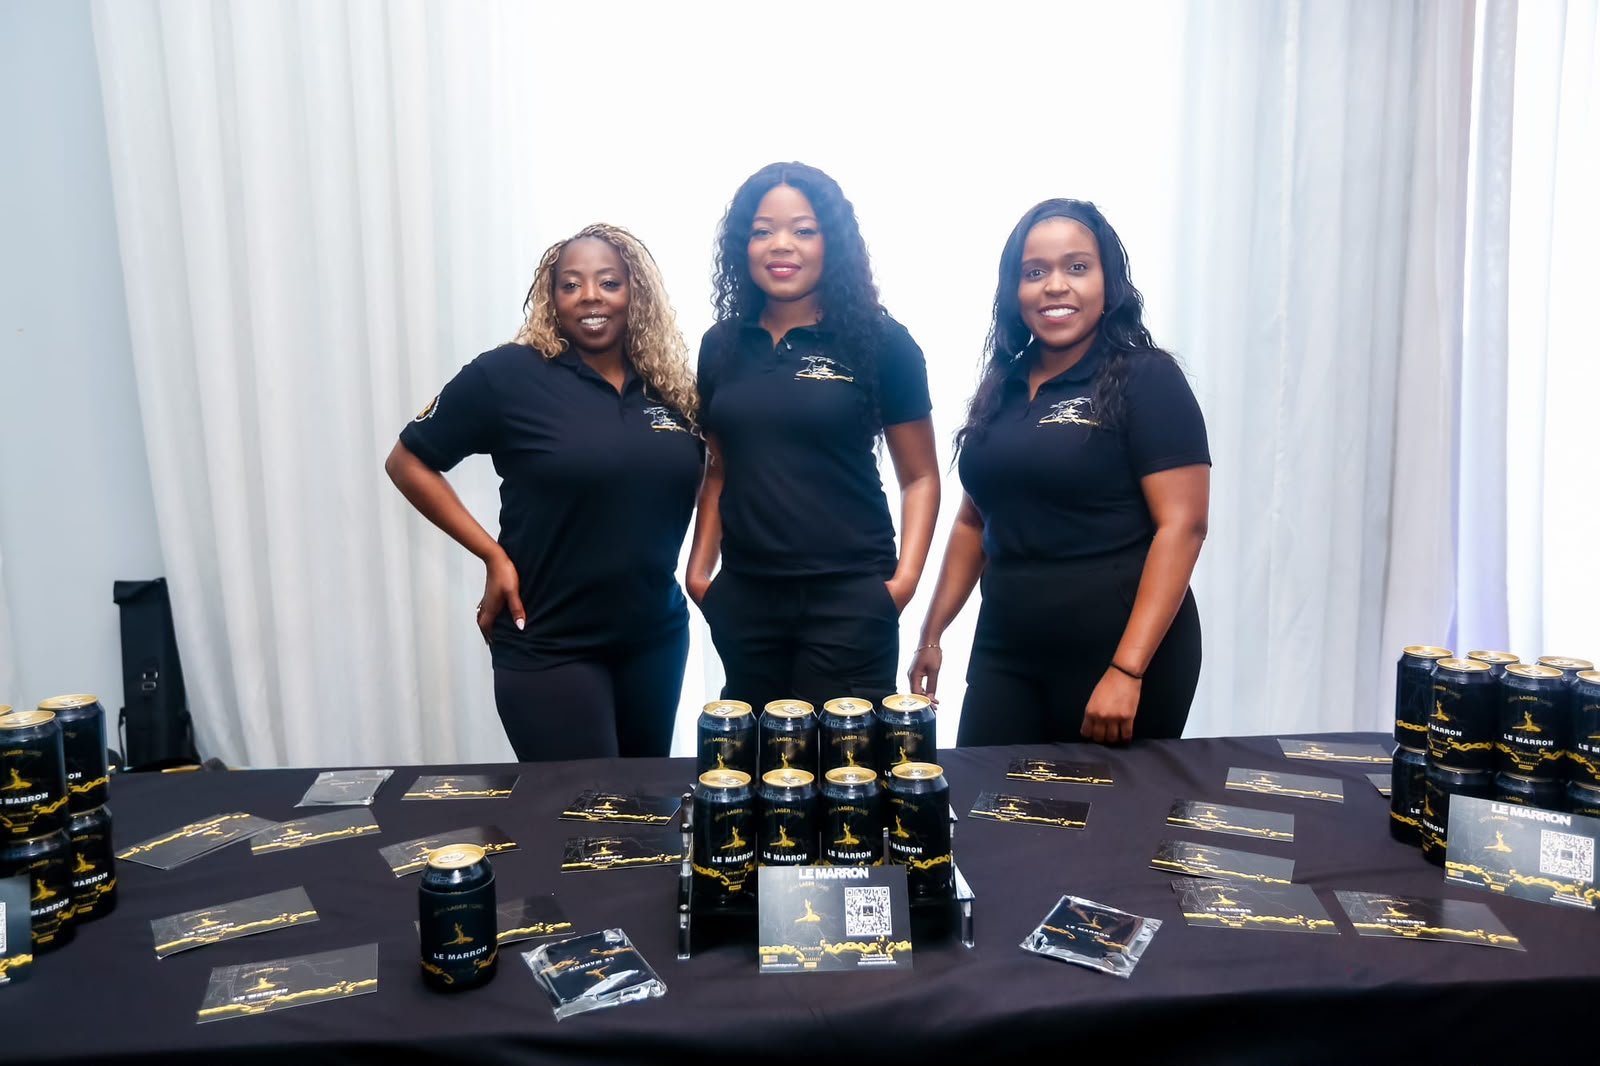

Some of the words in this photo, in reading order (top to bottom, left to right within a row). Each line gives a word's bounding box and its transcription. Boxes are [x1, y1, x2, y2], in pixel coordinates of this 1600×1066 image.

[1503, 733, 1513, 741] LE
[1515, 736, 1554, 746] MARRON
[1578, 743, 1589, 751] LE
[5, 792, 49, 805] MARRON
[1491, 803, 1509, 815] LE
[1509, 806, 1572, 826] MARRON
[827, 848, 836, 857] LE
[838, 850, 872, 859] MARRON
[891, 841, 923, 854] MARRON
[712, 855, 722, 863] LE
[725, 850, 754, 863] MARRON
[763, 851, 772, 859] LE
[773, 853, 807, 861] MARRON
[799, 868, 814, 879] LE
[815, 867, 869, 879] MARRON
[31, 898, 70, 917] MARRON
[433, 952, 444, 960] LE
[447, 945, 487, 961] MARRON
